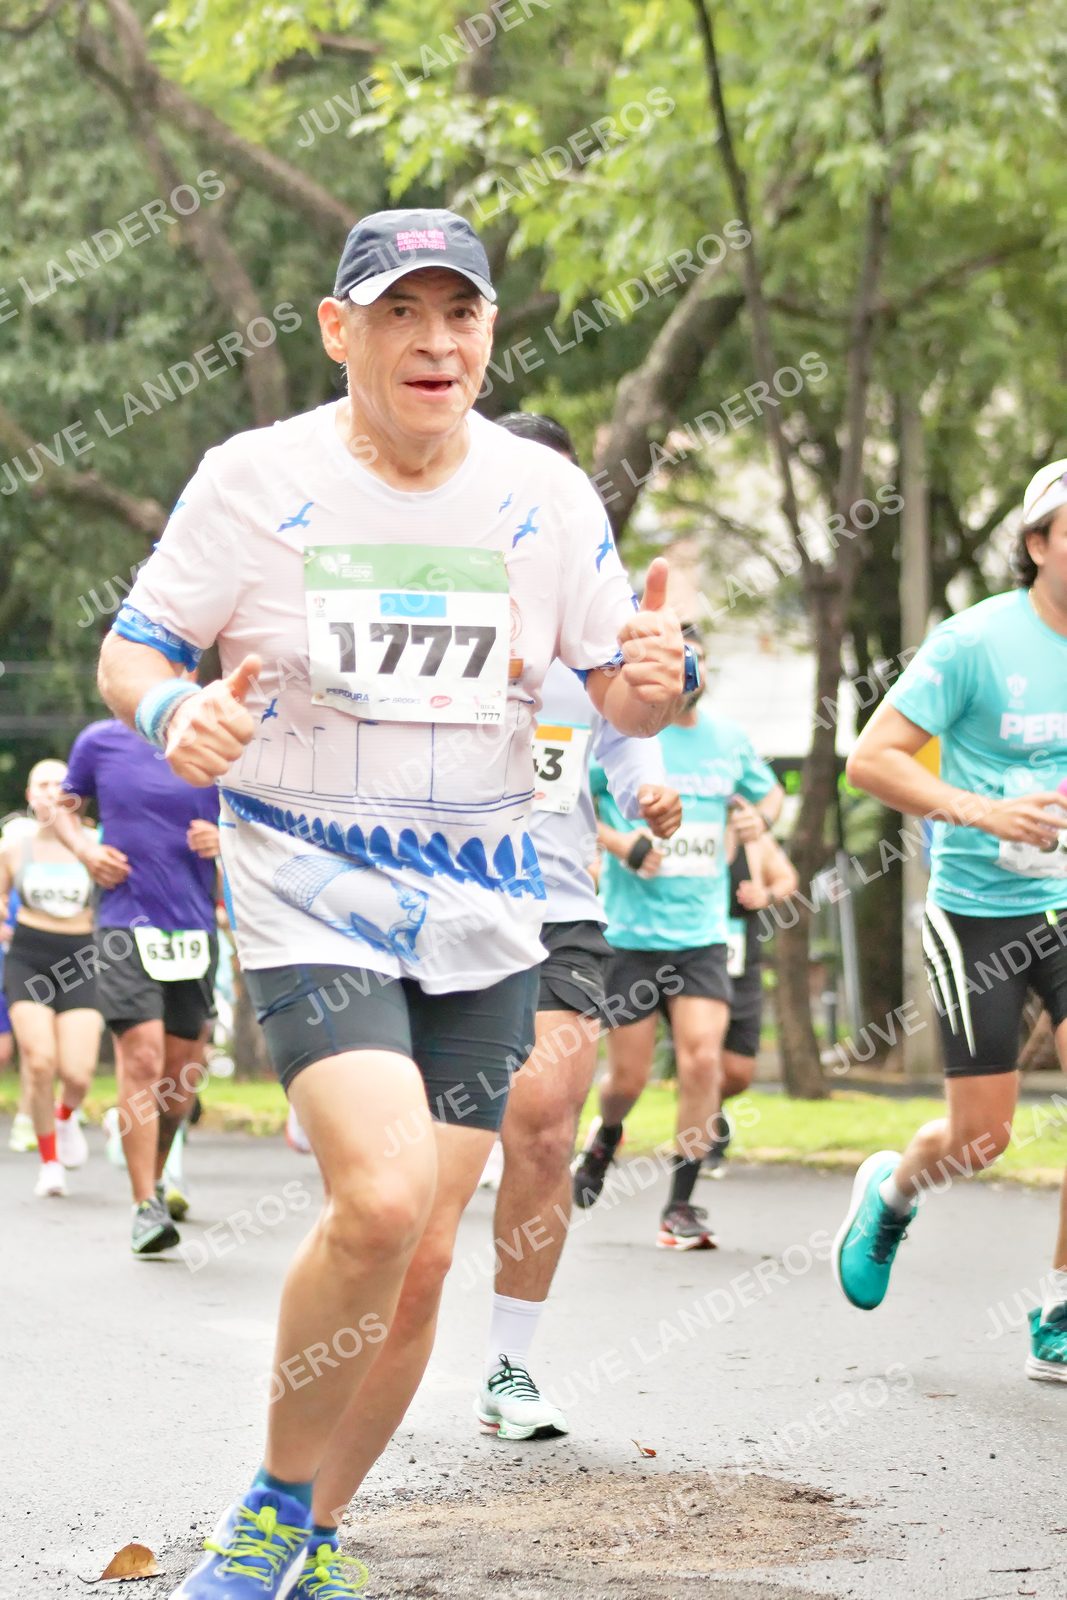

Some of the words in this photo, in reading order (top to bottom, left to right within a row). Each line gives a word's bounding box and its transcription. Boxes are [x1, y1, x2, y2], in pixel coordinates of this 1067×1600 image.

[329, 621, 497, 679] 1777
[474, 711, 501, 721] 1777
[1000, 712, 1067, 744] PER
[146, 940, 201, 961] 6319
